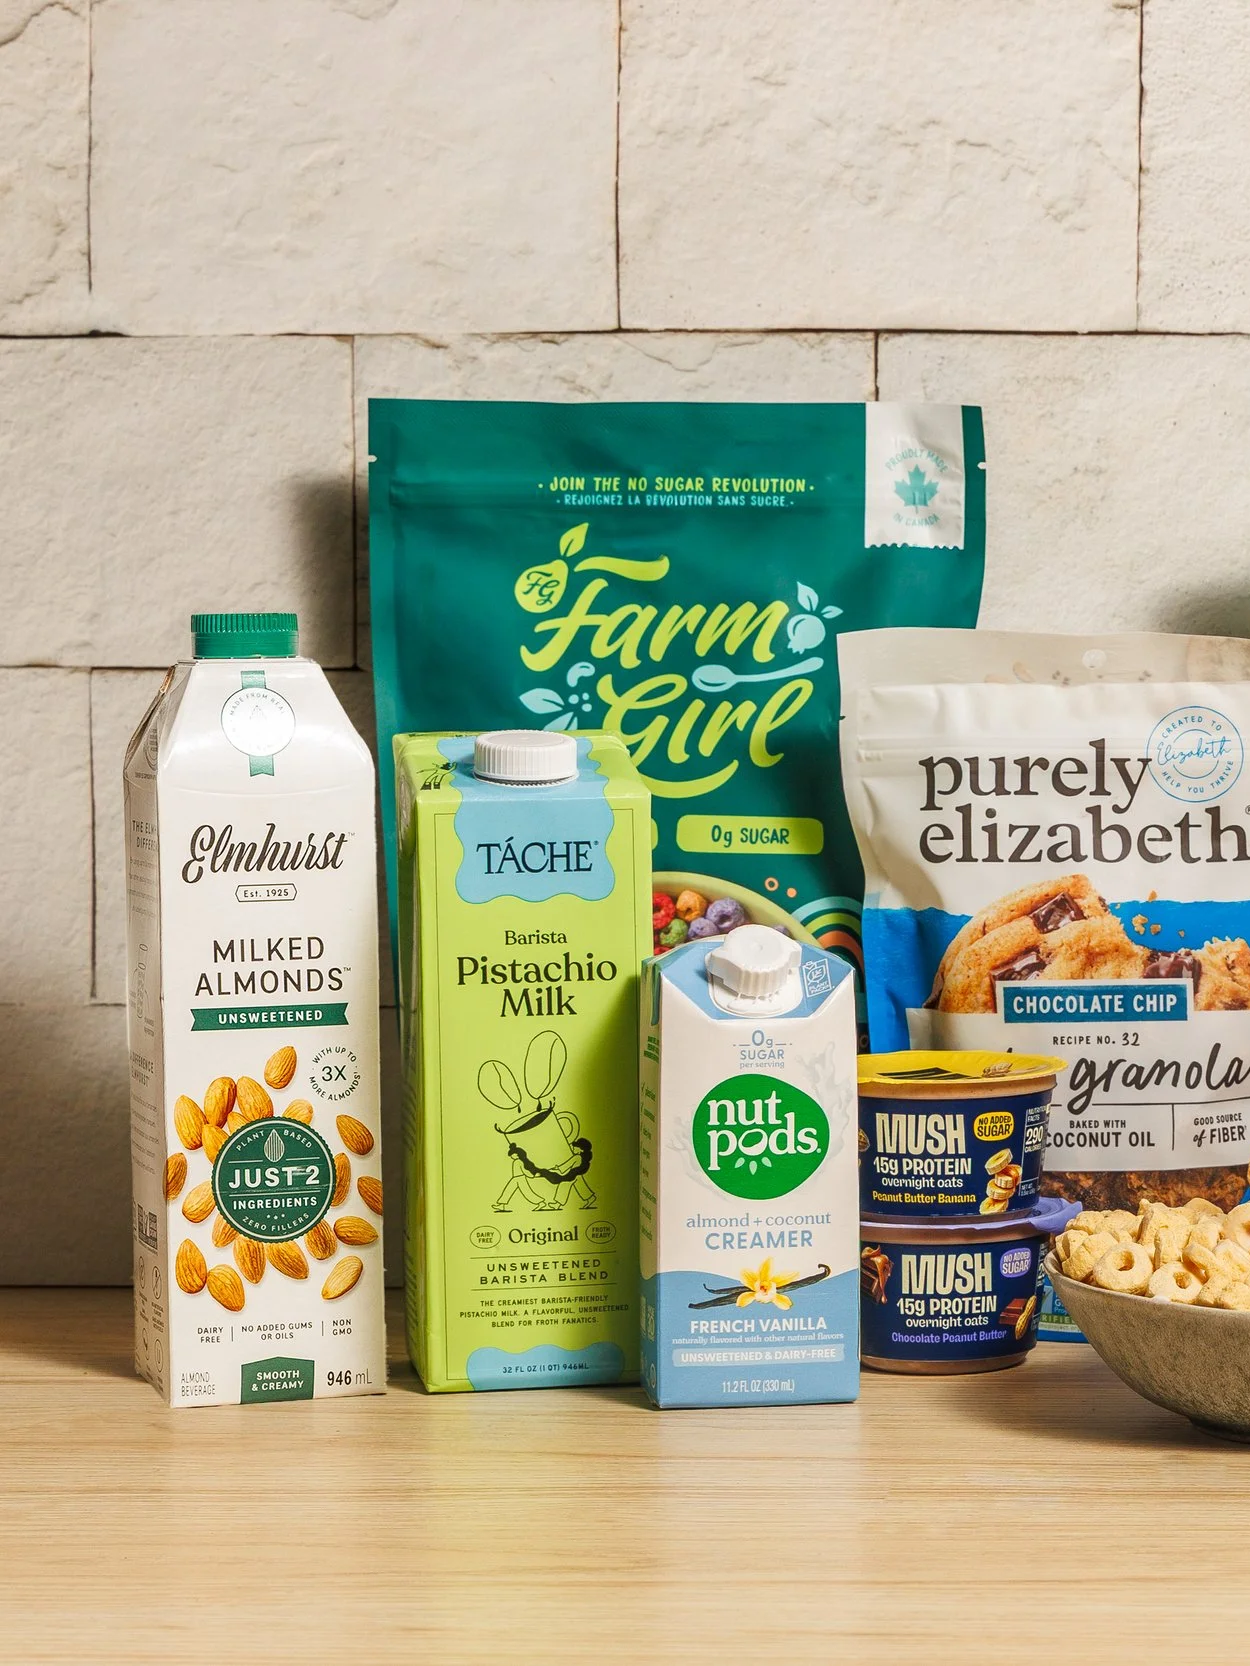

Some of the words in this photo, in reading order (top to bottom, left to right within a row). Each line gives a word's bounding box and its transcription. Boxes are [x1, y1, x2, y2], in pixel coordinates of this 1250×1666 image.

[550, 477, 585, 491] JOIN
[593, 477, 621, 491] THE
[628, 477, 648, 491] NO
[655, 477, 705, 492] SUGAR
[712, 478, 806, 493] REVOLUTION
[520, 555, 790, 672] Farm
[919, 738, 1152, 812] purely
[711, 825, 732, 848] 0g
[740, 828, 790, 845] SUGAR
[476, 836, 593, 875] TÁCHE
[243, 889, 262, 898] Est.
[266, 887, 289, 897] 1925
[504, 930, 568, 946] Barista
[213, 936, 325, 963] MILKED
[456, 951, 618, 986] Pistachio
[500, 985, 577, 1018] Milk
[1013, 994, 1124, 1014] CHOCOLATE
[1132, 993, 1178, 1012] CHIP
[218, 1009, 324, 1025] UNSWEETENED
[751, 1029, 773, 1050] 0g
[1052, 1035, 1091, 1046] RECIPE
[1096, 1034, 1116, 1045] NO.
[1121, 1032, 1141, 1047] 32
[312, 1046, 332, 1065] WITH
[335, 1046, 346, 1054] UP
[347, 1050, 357, 1062] TO
[739, 1050, 785, 1061] SUGAR
[321, 1065, 347, 1082] 3X
[308, 1076, 326, 1100] MORE
[707, 1090, 782, 1126] nut
[978, 1117, 988, 1126] NO
[990, 1115, 1012, 1125] ADDED
[1069, 1120, 1100, 1129] BAKED
[1104, 1119, 1127, 1129] WITH
[1193, 1116, 1214, 1126] GOOD
[1217, 1113, 1243, 1124] SOURCE
[236, 1130, 265, 1151] PLANT
[283, 1129, 312, 1149] BASED
[875, 1112, 966, 1156] MUSH
[1128, 1131, 1156, 1148] OIL
[1193, 1128, 1207, 1148] of
[873, 1156, 899, 1176] 15g
[902, 1157, 972, 1175] PROTEIN
[228, 1166, 294, 1189] JUST
[305, 1165, 320, 1185] 2
[881, 1176, 936, 1190] overnight
[938, 1177, 964, 1188] oats
[233, 1196, 318, 1210] INGREDIENTS
[872, 1190, 902, 1202] Peanut
[904, 1192, 936, 1203] Butter
[938, 1192, 976, 1203] Banana
[242, 1215, 267, 1231] ZERO
[271, 1212, 310, 1232] FILLERS
[686, 1213, 749, 1229] almond
[765, 1212, 832, 1226] coconut
[508, 1225, 579, 1246] Original
[705, 1230, 813, 1250] CREAMER
[487, 1259, 601, 1272] UNSWEETENED
[901, 1252, 992, 1295] MUSH
[480, 1274, 548, 1285] BARISTA
[558, 1271, 609, 1282] BLEND
[498, 1298, 538, 1306] CREAMIEST
[897, 1298, 926, 1316] 15g
[929, 1295, 997, 1315] PROTEIN
[241, 1325, 253, 1333] NO
[256, 1323, 286, 1332] ADDED
[288, 1321, 313, 1330] GUMS
[332, 1319, 352, 1327] NON
[690, 1319, 755, 1333] FRENCH
[759, 1316, 828, 1332] VANILLA
[906, 1316, 963, 1330] overnight
[964, 1314, 989, 1326] oats
[197, 1326, 224, 1335] DAIRY
[261, 1333, 273, 1341] OR
[275, 1332, 294, 1340] OILS
[332, 1327, 353, 1336] GMO
[891, 1331, 940, 1344] Chocolate
[942, 1331, 978, 1343] Peanut
[979, 1330, 1007, 1341] Butter
[200, 1335, 221, 1343] FREE
[681, 1351, 763, 1363] UNSWEETENED
[765, 1350, 772, 1360] &
[774, 1348, 837, 1360] DAIRY-FREE
[181, 1372, 210, 1383] ALMOND
[256, 1369, 300, 1380] SMOOTH
[327, 1371, 352, 1386] 946
[355, 1368, 373, 1385] mL
[181, 1385, 216, 1397] BEVERAGE
[252, 1382, 259, 1391] &
[261, 1380, 304, 1391] CREAMY
[722, 1380, 738, 1393] 11.2
[740, 1380, 749, 1392] FL
[751, 1380, 761, 1391] OZ
[762, 1379, 779, 1393] (330
